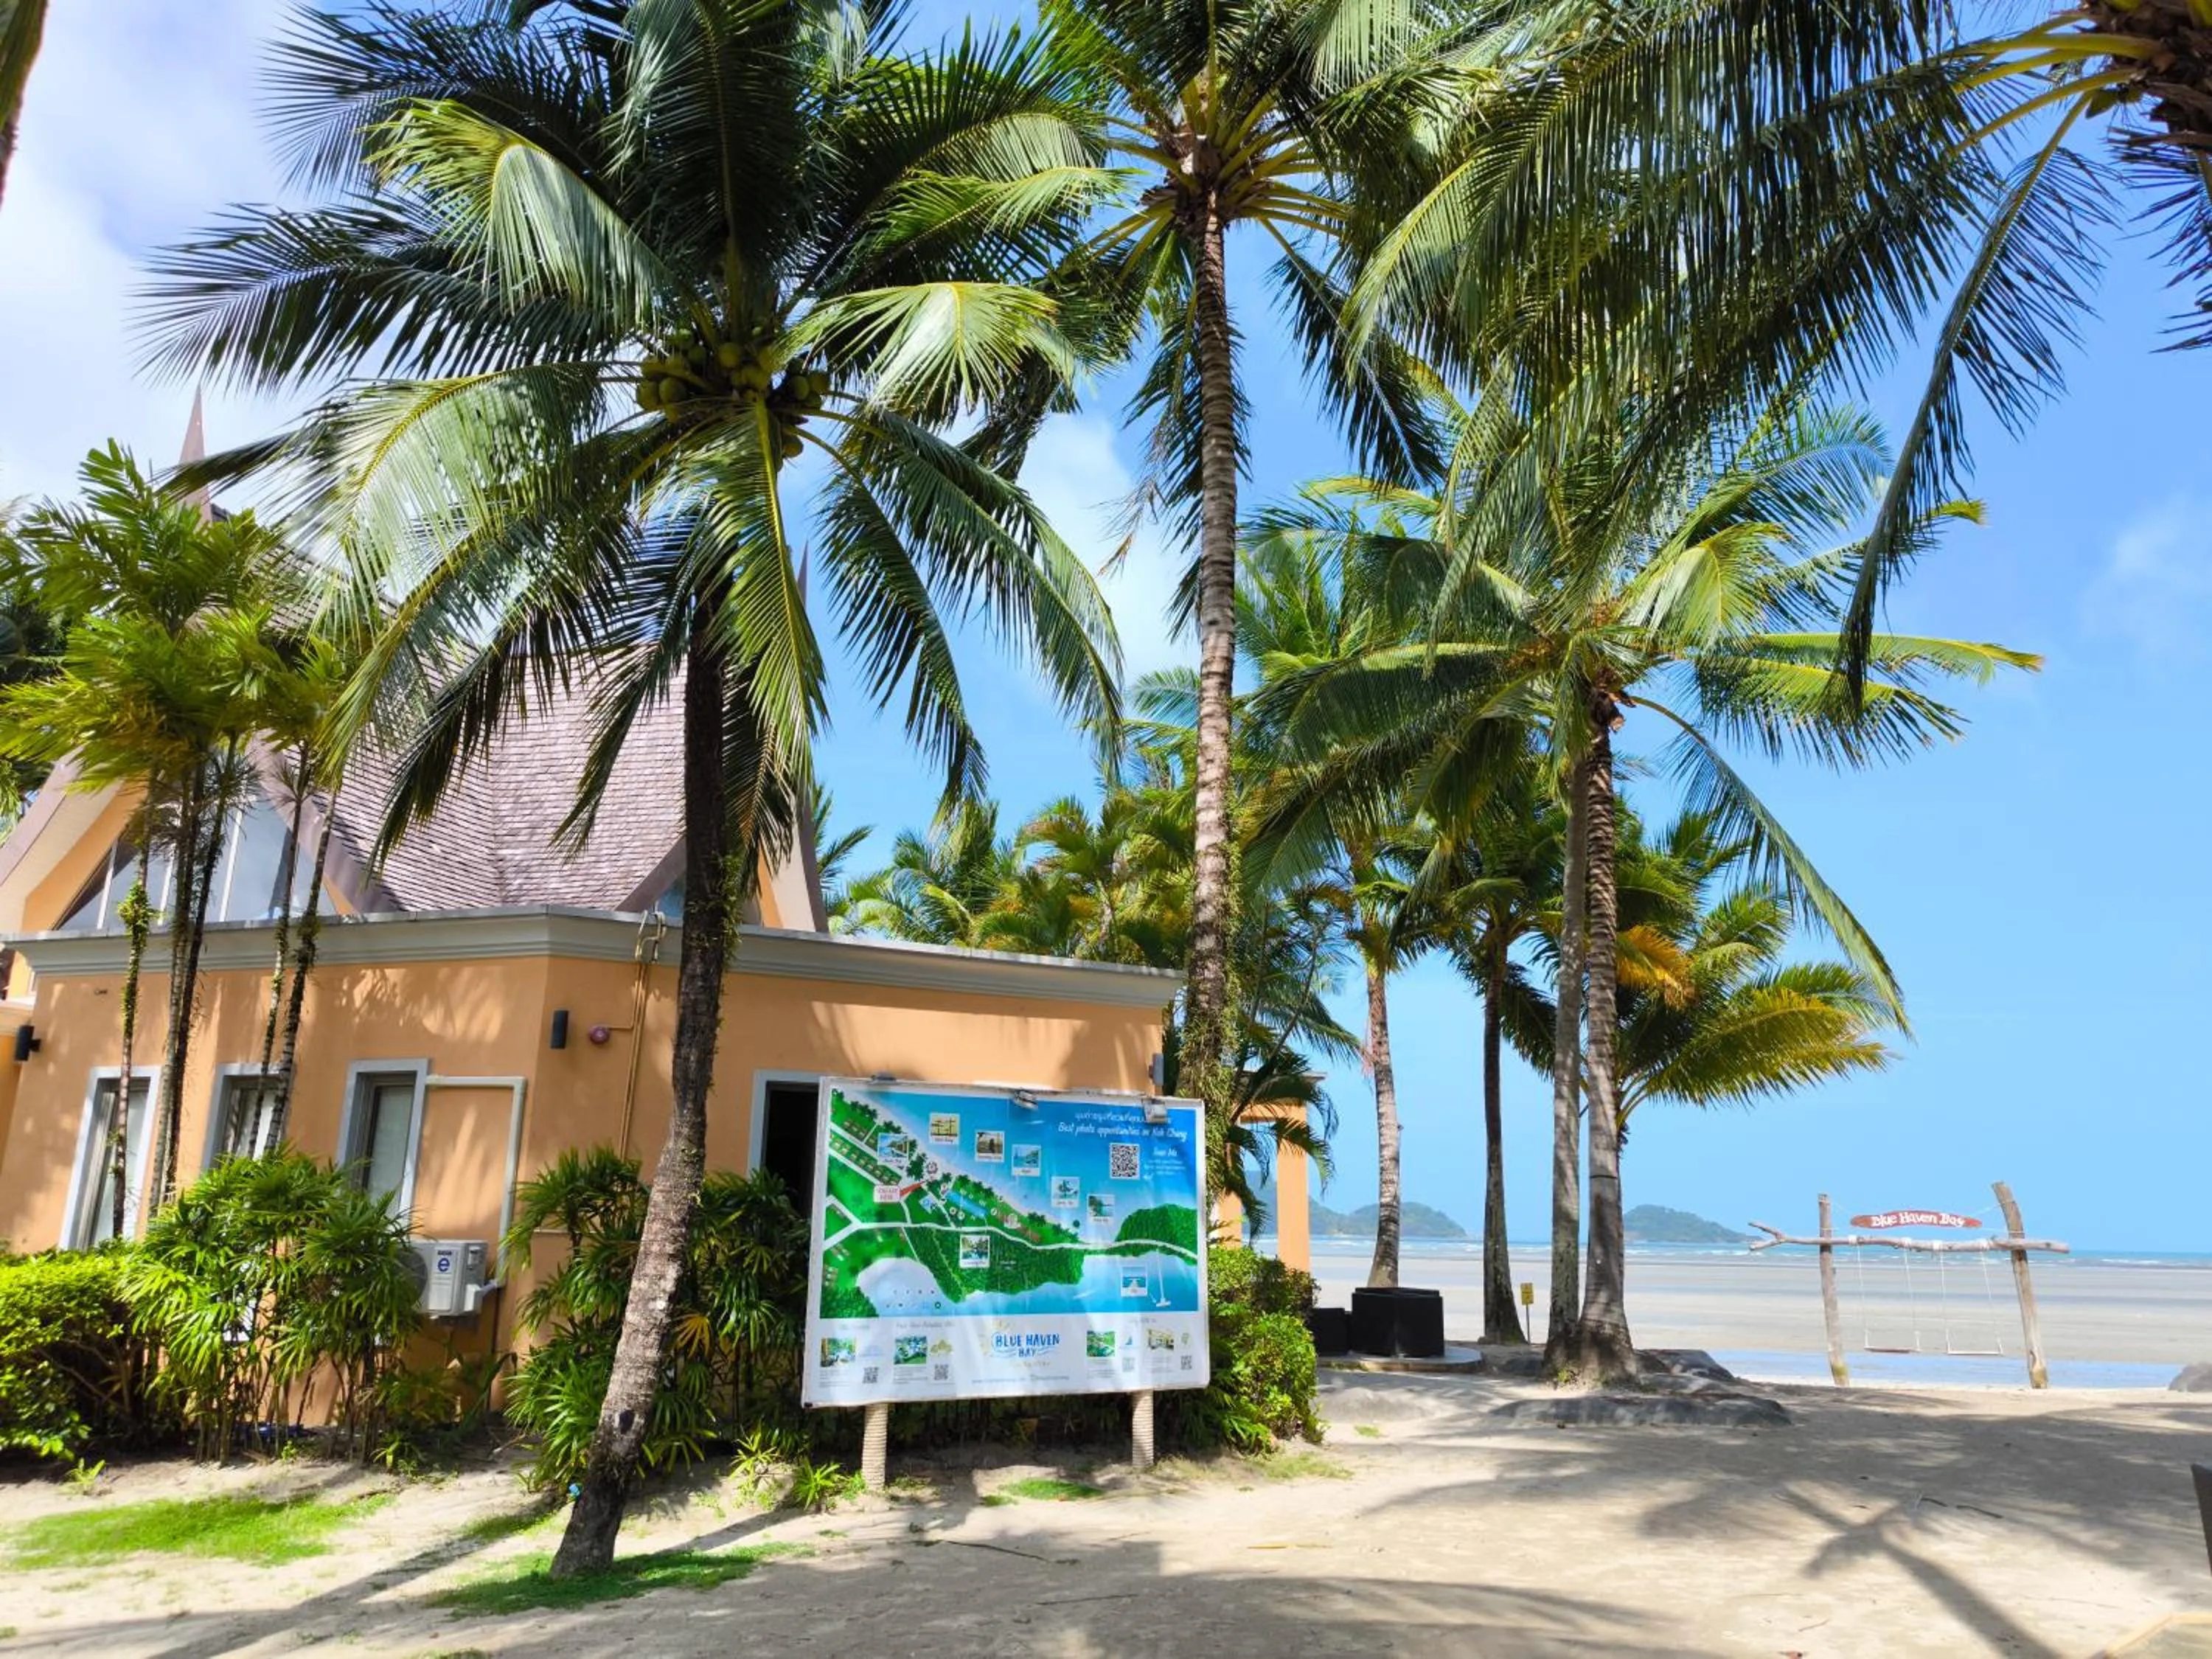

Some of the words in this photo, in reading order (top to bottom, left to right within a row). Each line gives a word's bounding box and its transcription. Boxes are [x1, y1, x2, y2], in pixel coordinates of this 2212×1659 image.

[1871, 1215, 1897, 1227] Blue
[1899, 1211, 1938, 1225] Haven
[1939, 1213, 1966, 1228] Bay
[995, 1334, 1022, 1347] BLUE
[1026, 1332, 1060, 1346] HAVEN
[1018, 1347, 1037, 1357] BAY
